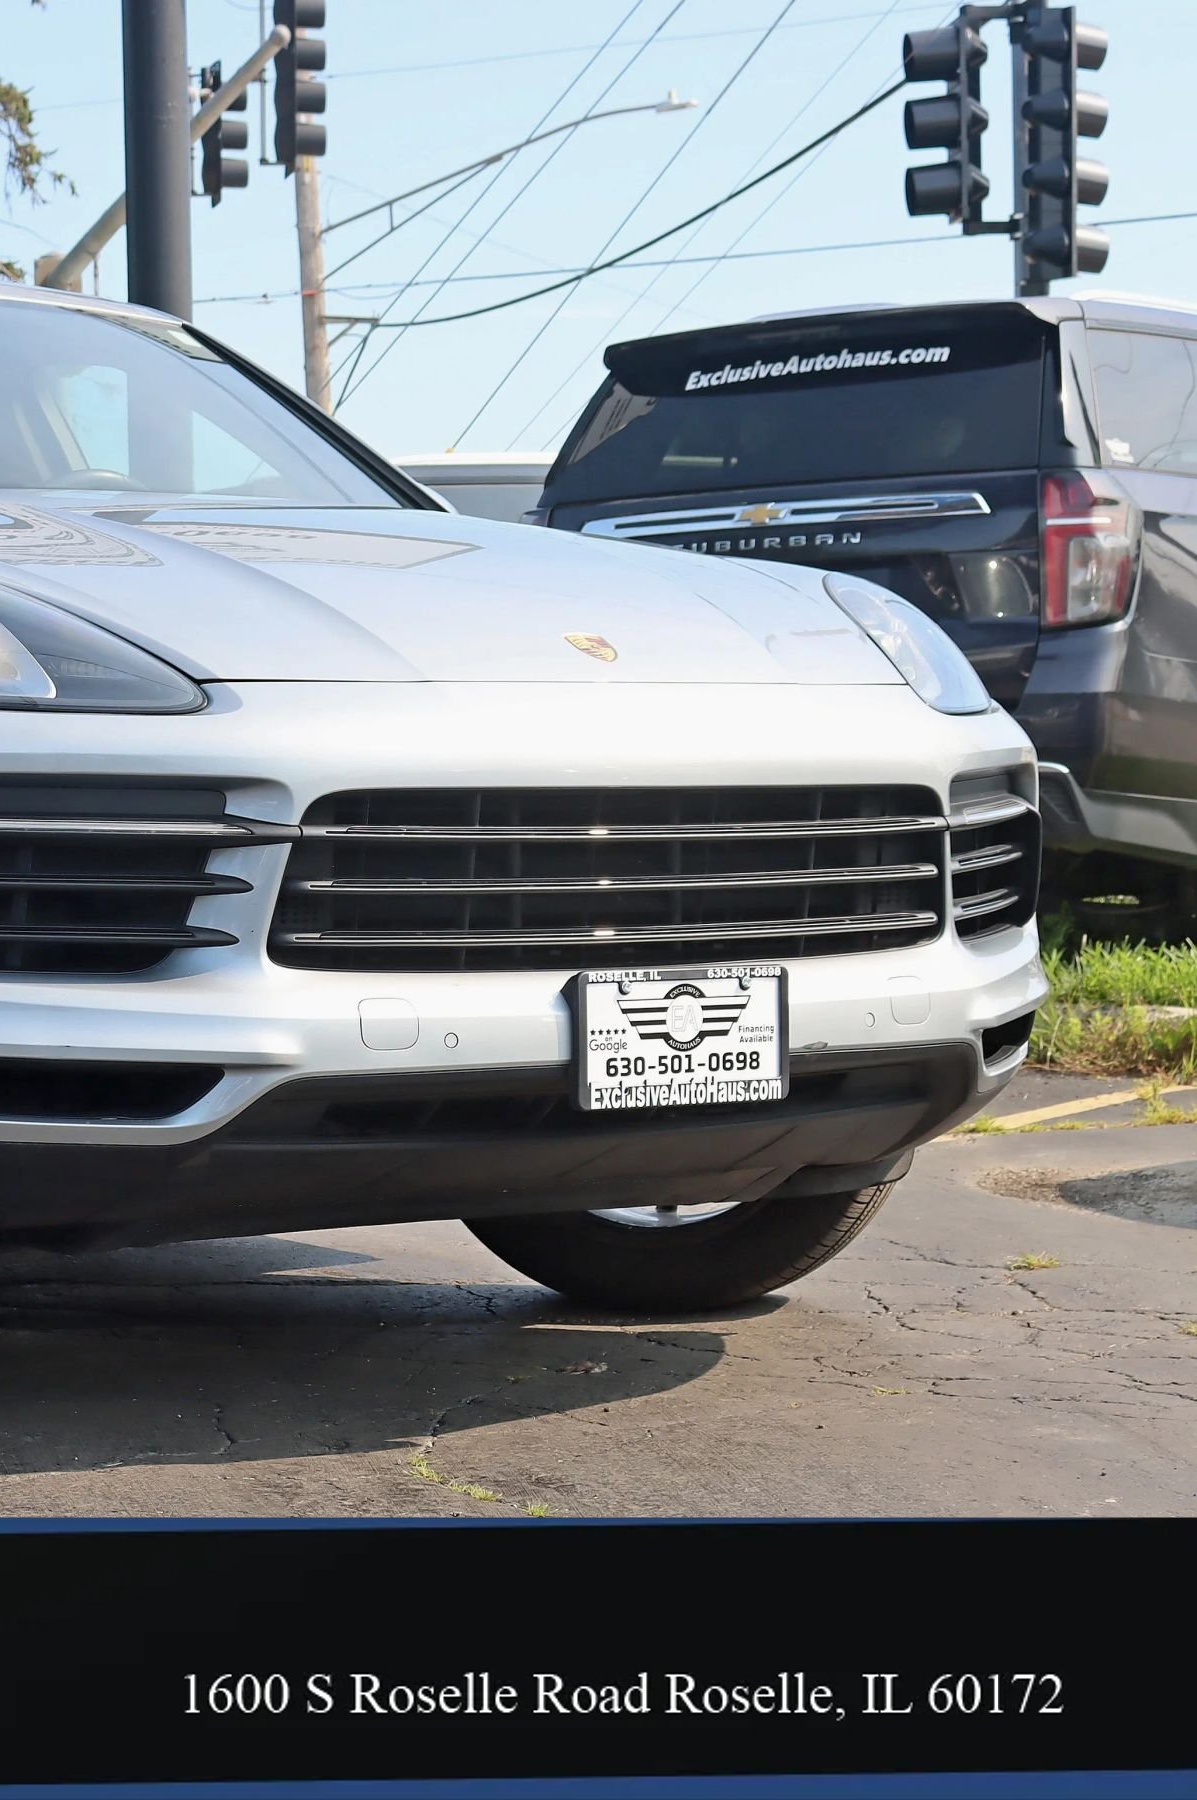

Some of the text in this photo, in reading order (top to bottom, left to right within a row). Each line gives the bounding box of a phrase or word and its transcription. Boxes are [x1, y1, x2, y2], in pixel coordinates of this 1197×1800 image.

[685, 346, 951, 391] ExclusiveAutohaus.com
[588, 970, 662, 982] ROSELLE, IL
[707, 967, 782, 978] 630-501-0698
[669, 985, 701, 998] EXCLUSIVE
[672, 1005, 698, 1033] EA
[738, 1025, 775, 1034] Financing
[668, 1036, 701, 1050] AUTOHAUS
[739, 1034, 774, 1043] Available
[589, 1039, 628, 1053] Google
[606, 1051, 761, 1077] 630-501-0698
[590, 1079, 783, 1110] ExclusiveAutoHaus.com
